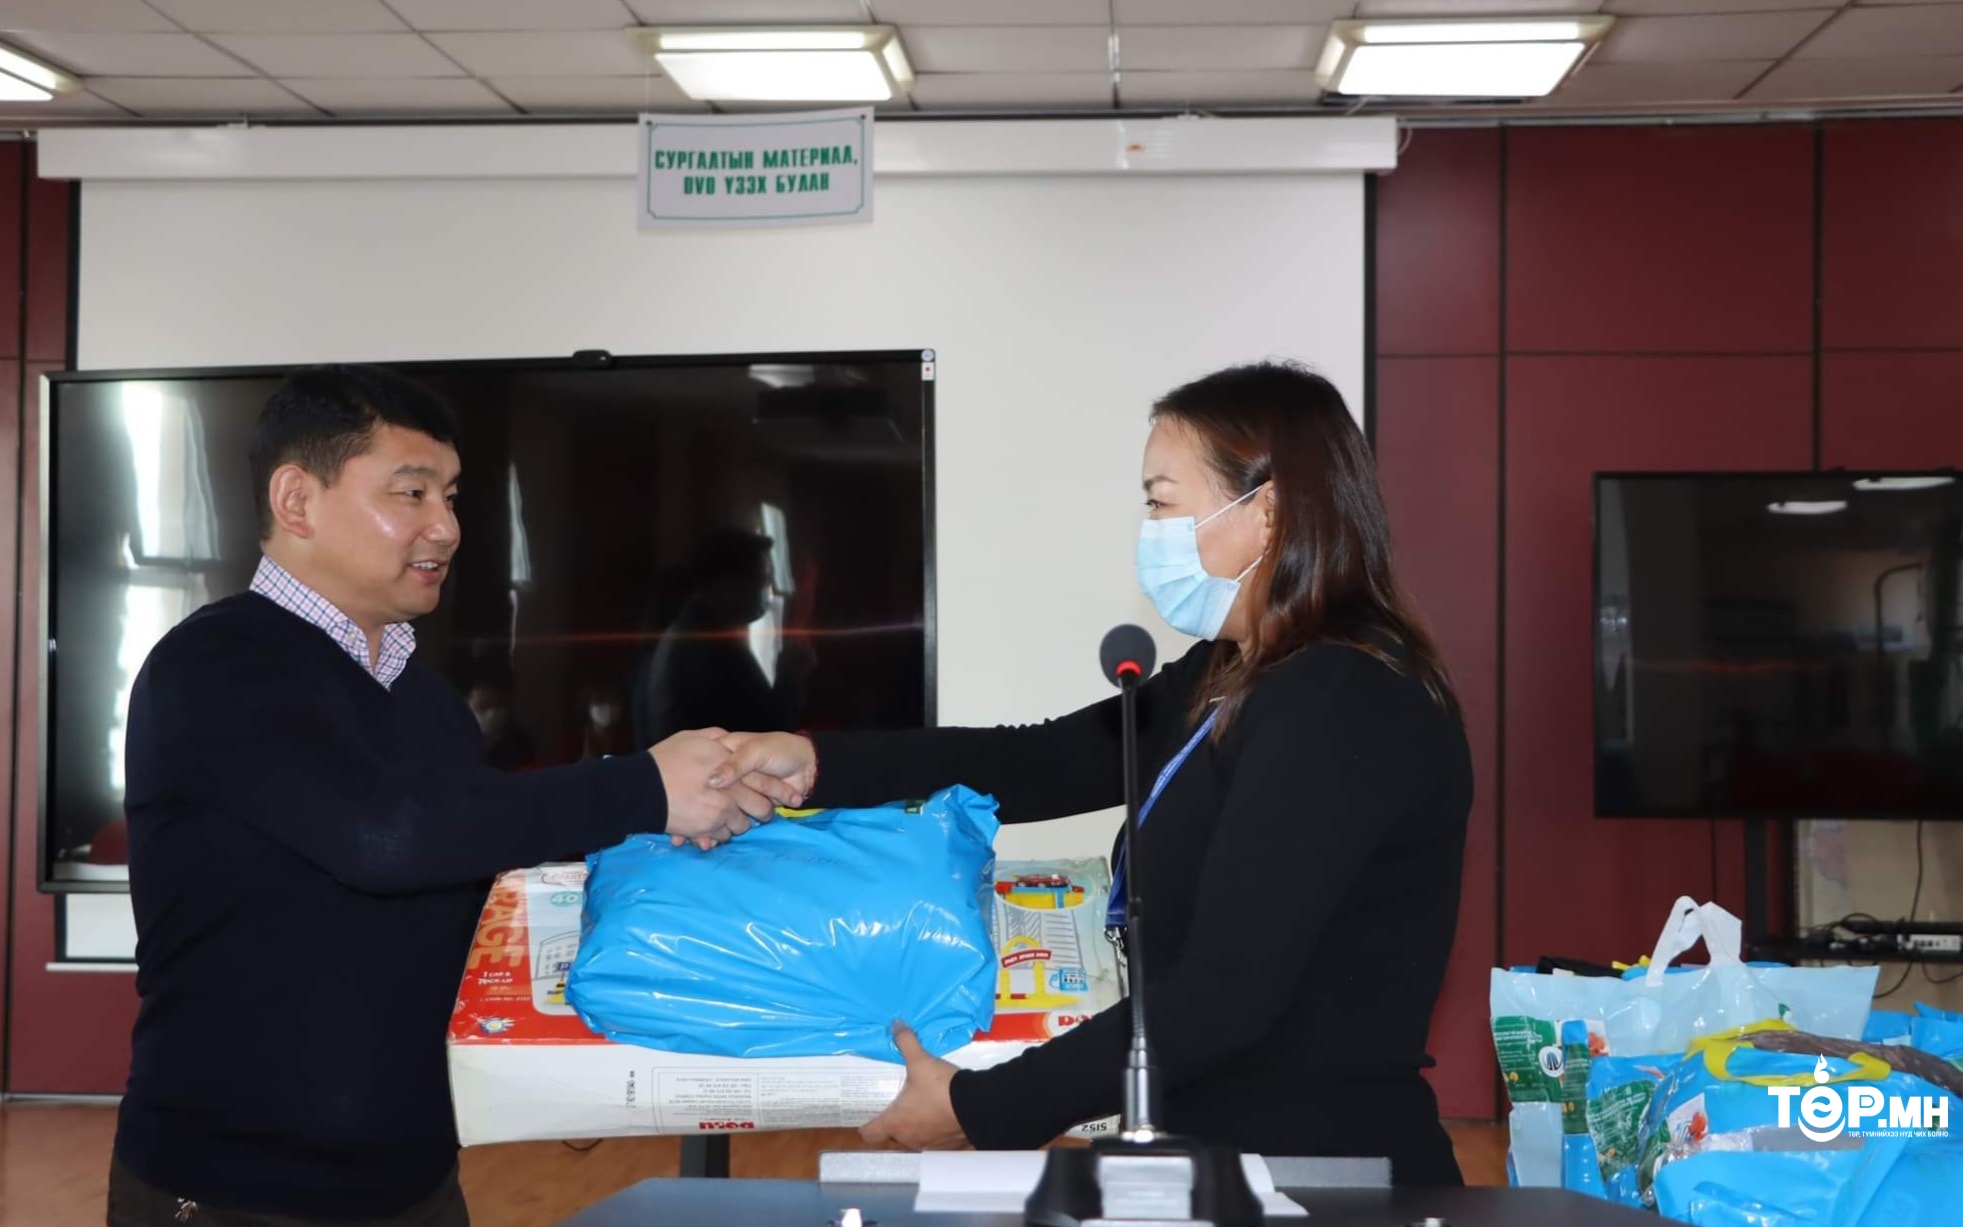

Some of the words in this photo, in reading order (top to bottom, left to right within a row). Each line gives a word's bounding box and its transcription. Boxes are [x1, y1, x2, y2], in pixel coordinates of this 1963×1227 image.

[655, 150, 754, 169] СУРГАЛТЫН
[763, 145, 858, 168] МАТЕРИАЛ,
[776, 172, 830, 193] БУЛАН
